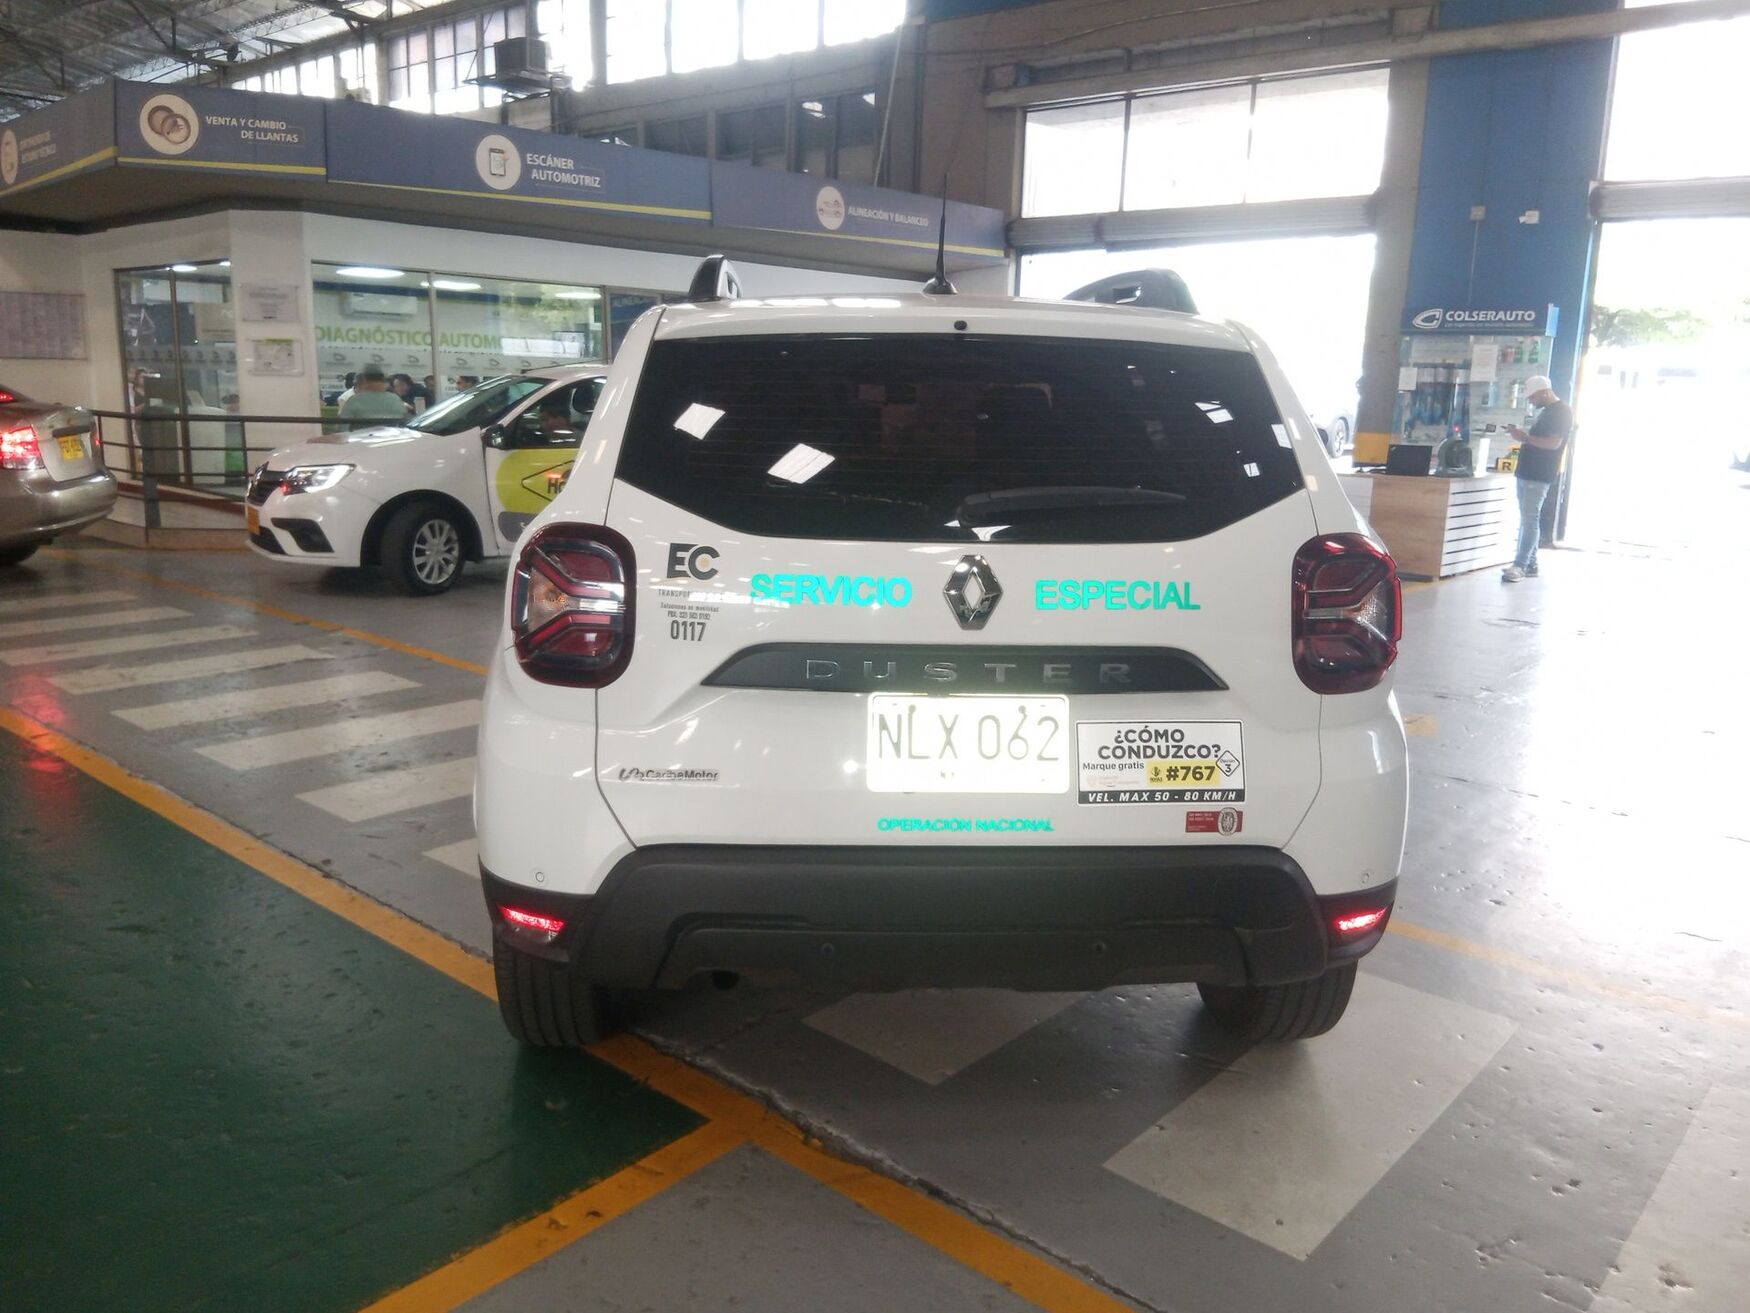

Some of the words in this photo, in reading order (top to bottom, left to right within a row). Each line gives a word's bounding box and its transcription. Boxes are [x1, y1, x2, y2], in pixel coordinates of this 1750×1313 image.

[205, 115, 238, 127] VENTA
[239, 118, 246, 127] Y
[247, 119, 287, 130] CAMBIO
[241, 130, 255, 139] DE
[256, 131, 299, 143] LLANTAS
[526, 153, 575, 170] ESCÁNER
[531, 169, 602, 188] AUTOMOTRIZ
[1445, 310, 1536, 322] COLSERAUTO
[316, 325, 433, 347] DIAGNÓSTICO
[440, 333, 503, 349] AUTOM
[666, 543, 720, 581] EC
[750, 573, 913, 608] SERVICIO
[1035, 579, 1201, 611] ESPECIAL
[670, 620, 706, 641] 0117
[806, 659, 1132, 684] DUSTER
[878, 711, 960, 760] NLX
[977, 711, 1060, 761] 062
[1114, 725, 1185, 744] ¿CÓMO
[1098, 744, 1221, 760] CONDUZCO?
[1082, 762, 1116, 771] Marque
[1118, 761, 1145, 771] gratis
[1166, 766, 1216, 781] #767
[1225, 763, 1232, 773] 3
[1088, 793, 1114, 802] VEL.
[1119, 792, 1150, 802] MAX
[1154, 792, 1171, 801] 50
[1184, 791, 1199, 801] 80
[1203, 791, 1236, 800] KM/H
[975, 818, 1056, 832] NACIONAL
